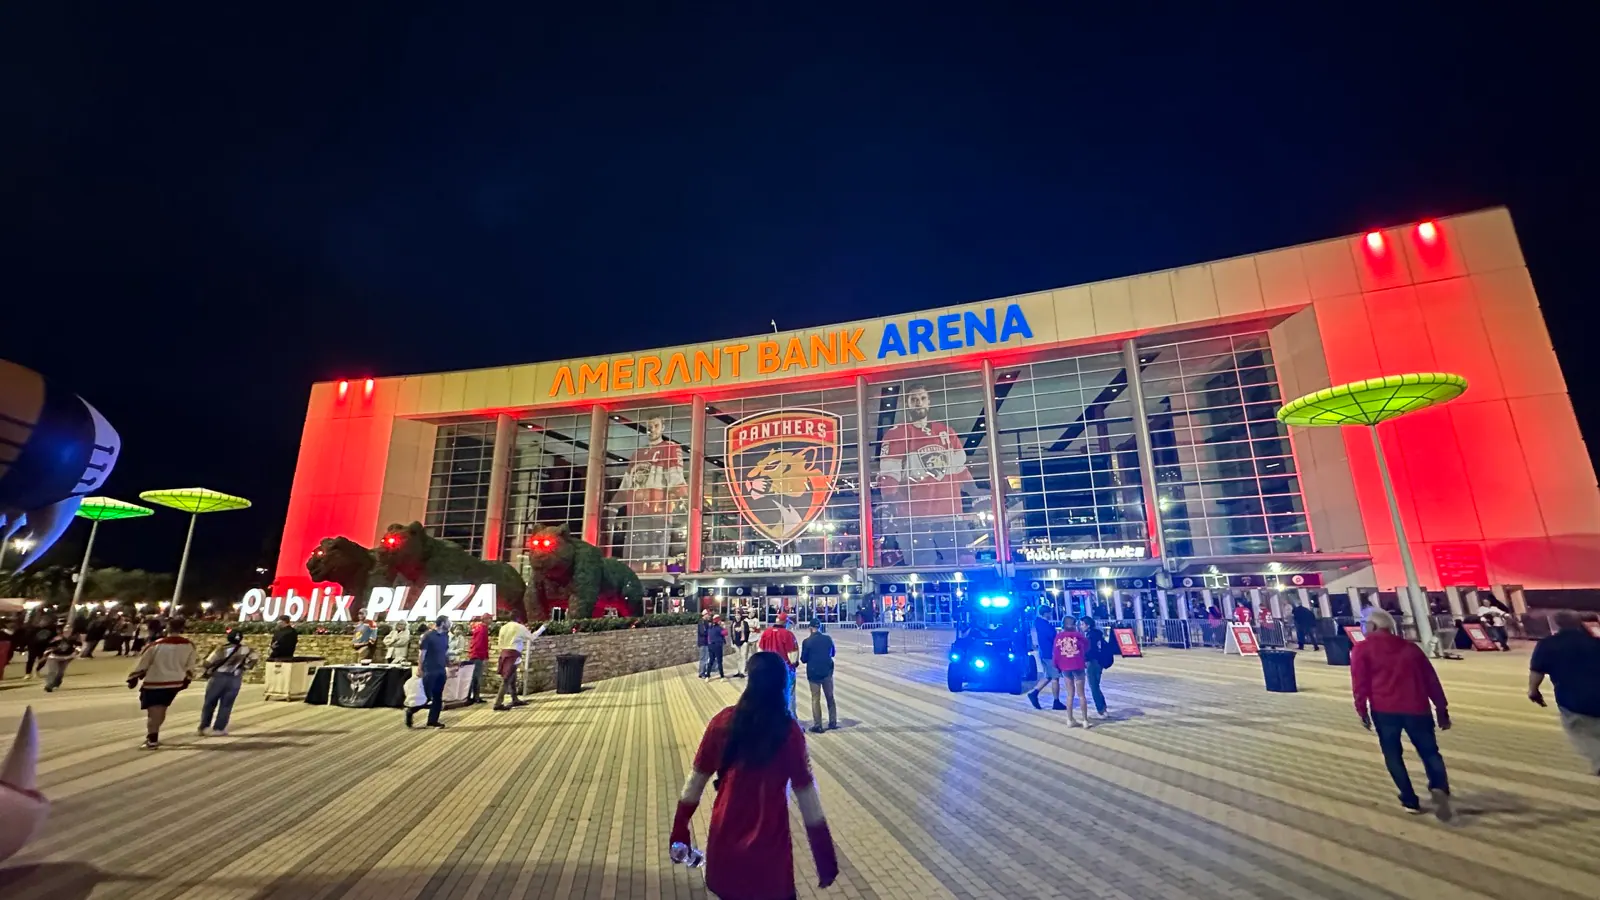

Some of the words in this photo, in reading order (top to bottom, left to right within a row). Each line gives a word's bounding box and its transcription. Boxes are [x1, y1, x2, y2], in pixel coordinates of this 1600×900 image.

[549, 344, 749, 397] AMERANT
[757, 327, 867, 374] BANK
[877, 304, 1034, 359] ARENA
[738, 420, 827, 446] PANTHERS
[721, 554, 802, 569] PANTHERLAND
[1070, 547, 1145, 560] ENTRANCE
[238, 587, 354, 622] Publix
[366, 583, 497, 622] PLAZA
